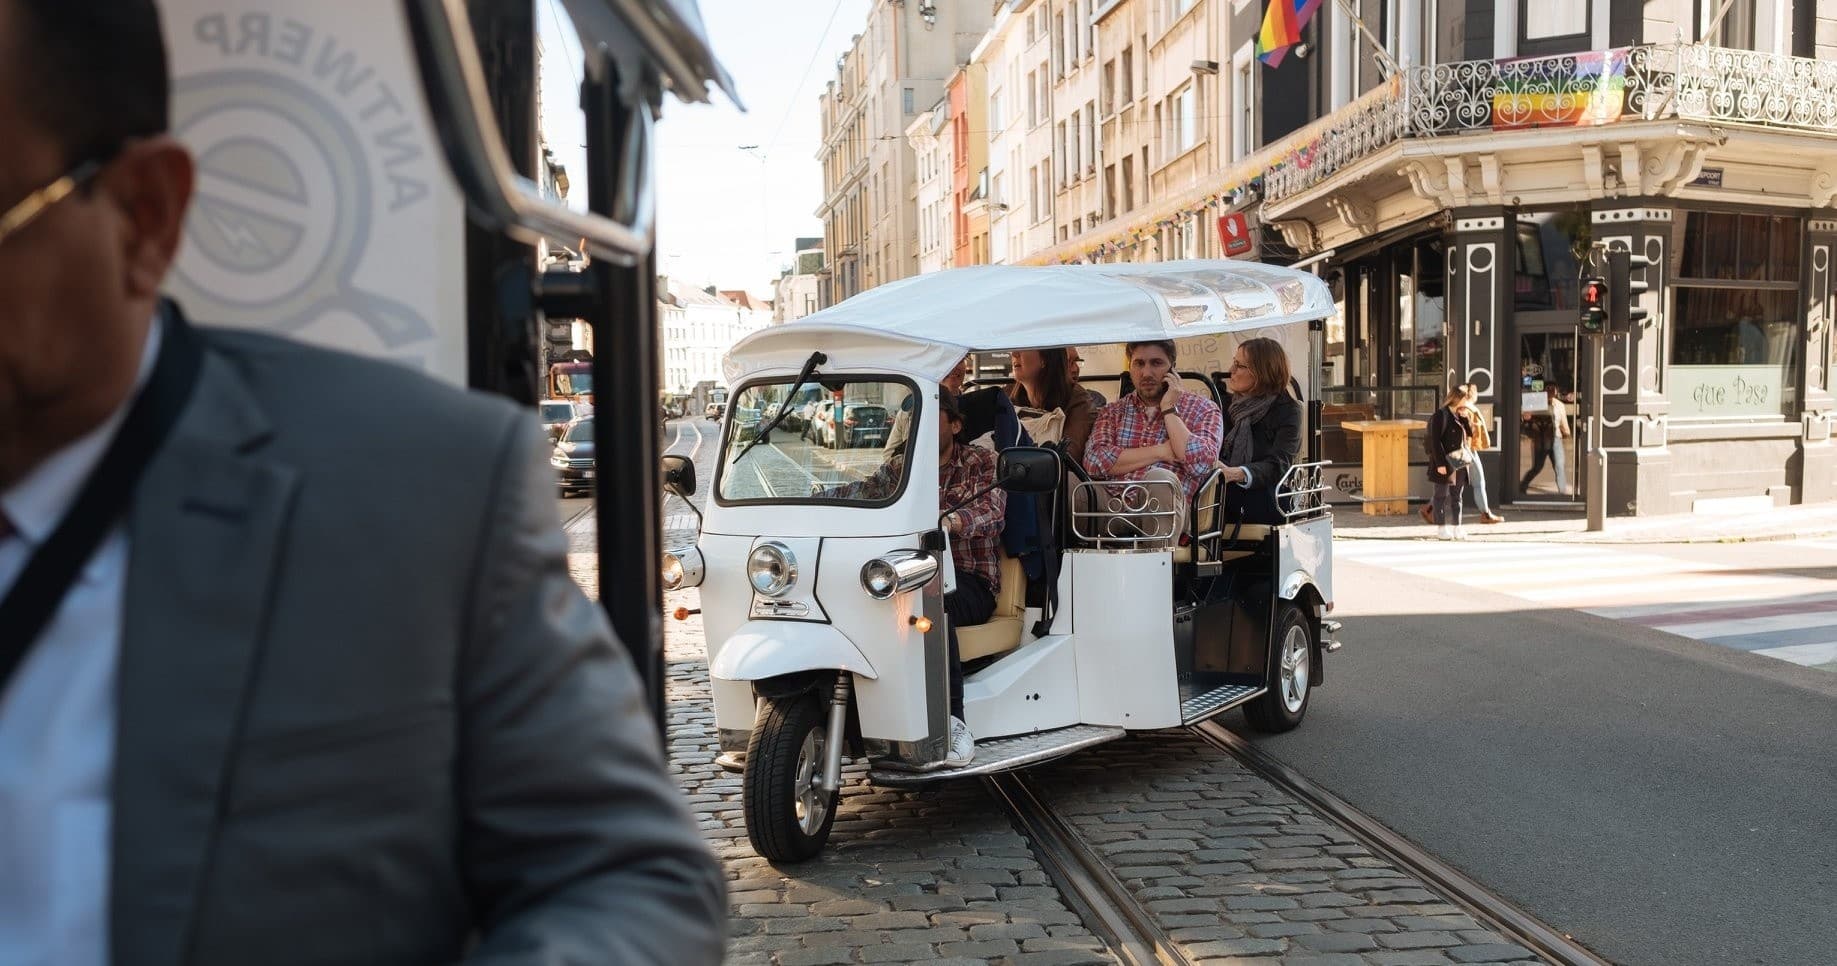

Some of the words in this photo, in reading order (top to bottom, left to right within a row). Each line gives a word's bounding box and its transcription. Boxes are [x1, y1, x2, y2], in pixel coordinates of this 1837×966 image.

[1693, 383, 1726, 412] que
[1733, 375, 1768, 406] Pasa
[1335, 473, 1364, 492] Carls
